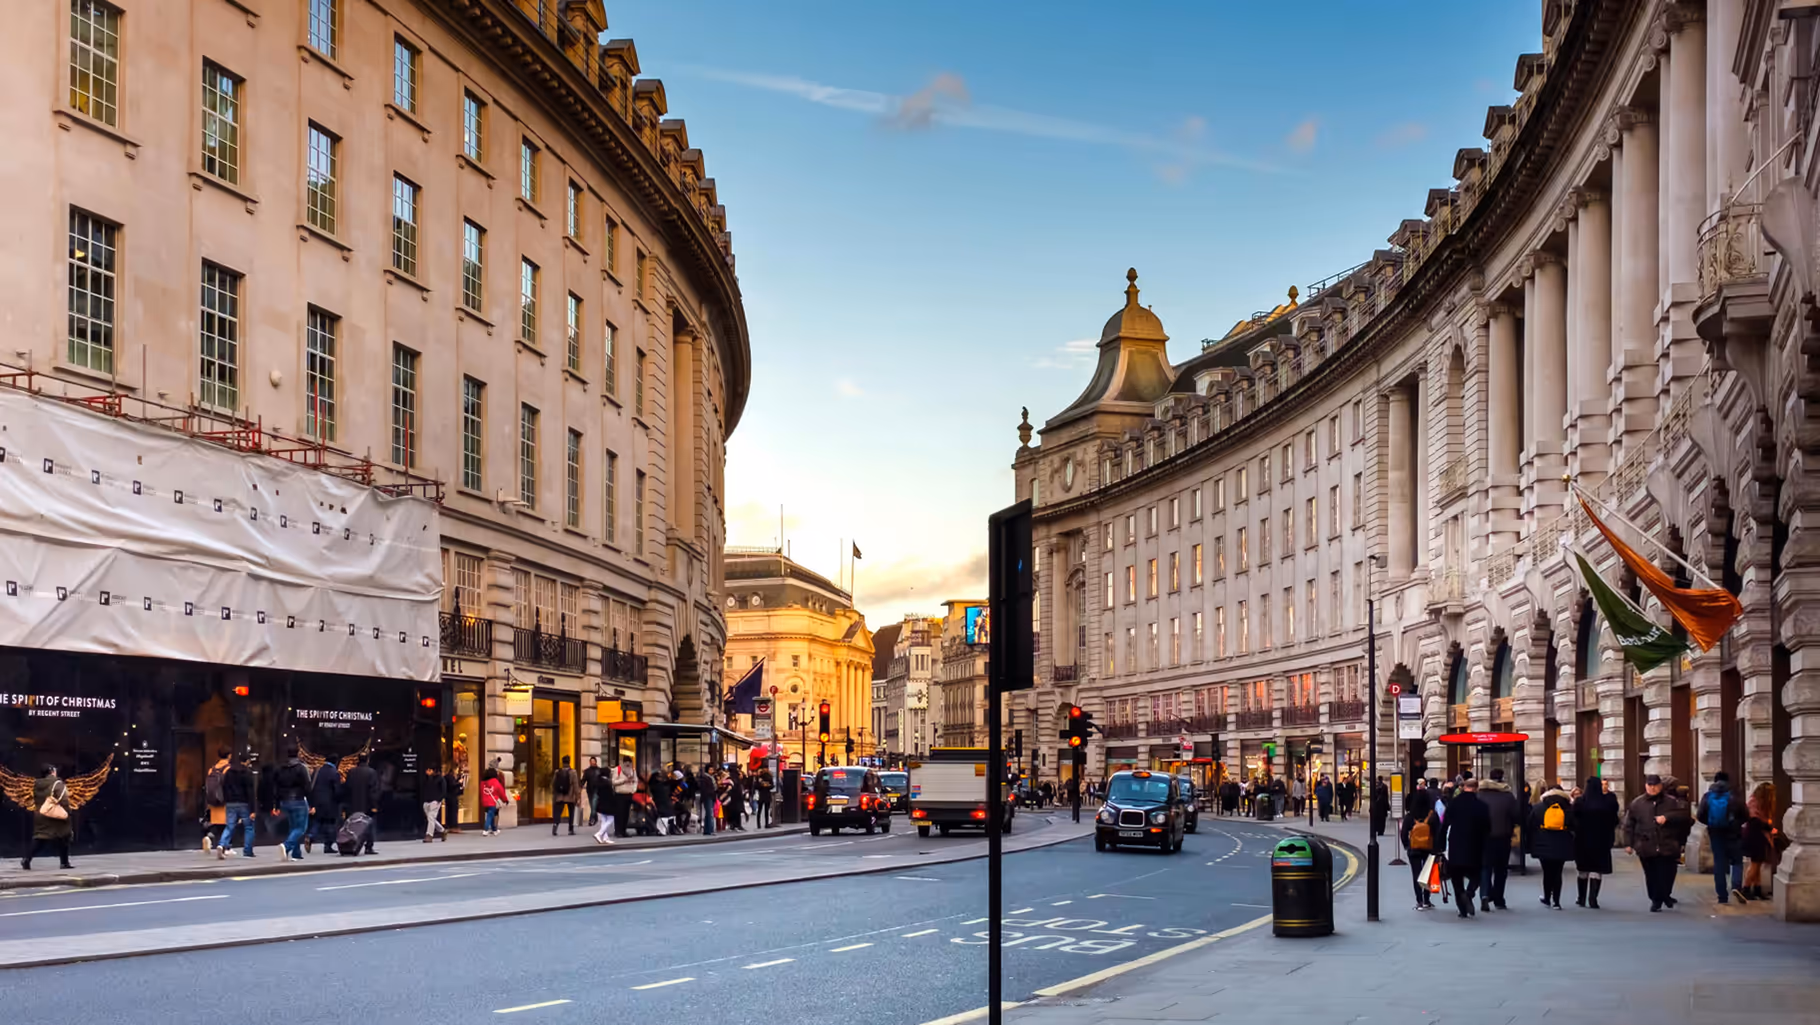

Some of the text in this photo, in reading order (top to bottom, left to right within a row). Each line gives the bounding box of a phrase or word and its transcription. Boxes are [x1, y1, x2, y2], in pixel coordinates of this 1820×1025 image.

[1392, 685, 1400, 693] D
[46, 696, 60, 706] OF
[62, 697, 116, 708] CHRISTMAS
[37, 709, 59, 717] REGENT
[296, 709, 308, 718] THE
[329, 711, 338, 719] OF
[338, 711, 372, 721] CHRISTMAS
[1001, 917, 1207, 938] STOP
[950, 931, 1138, 954] BUS
